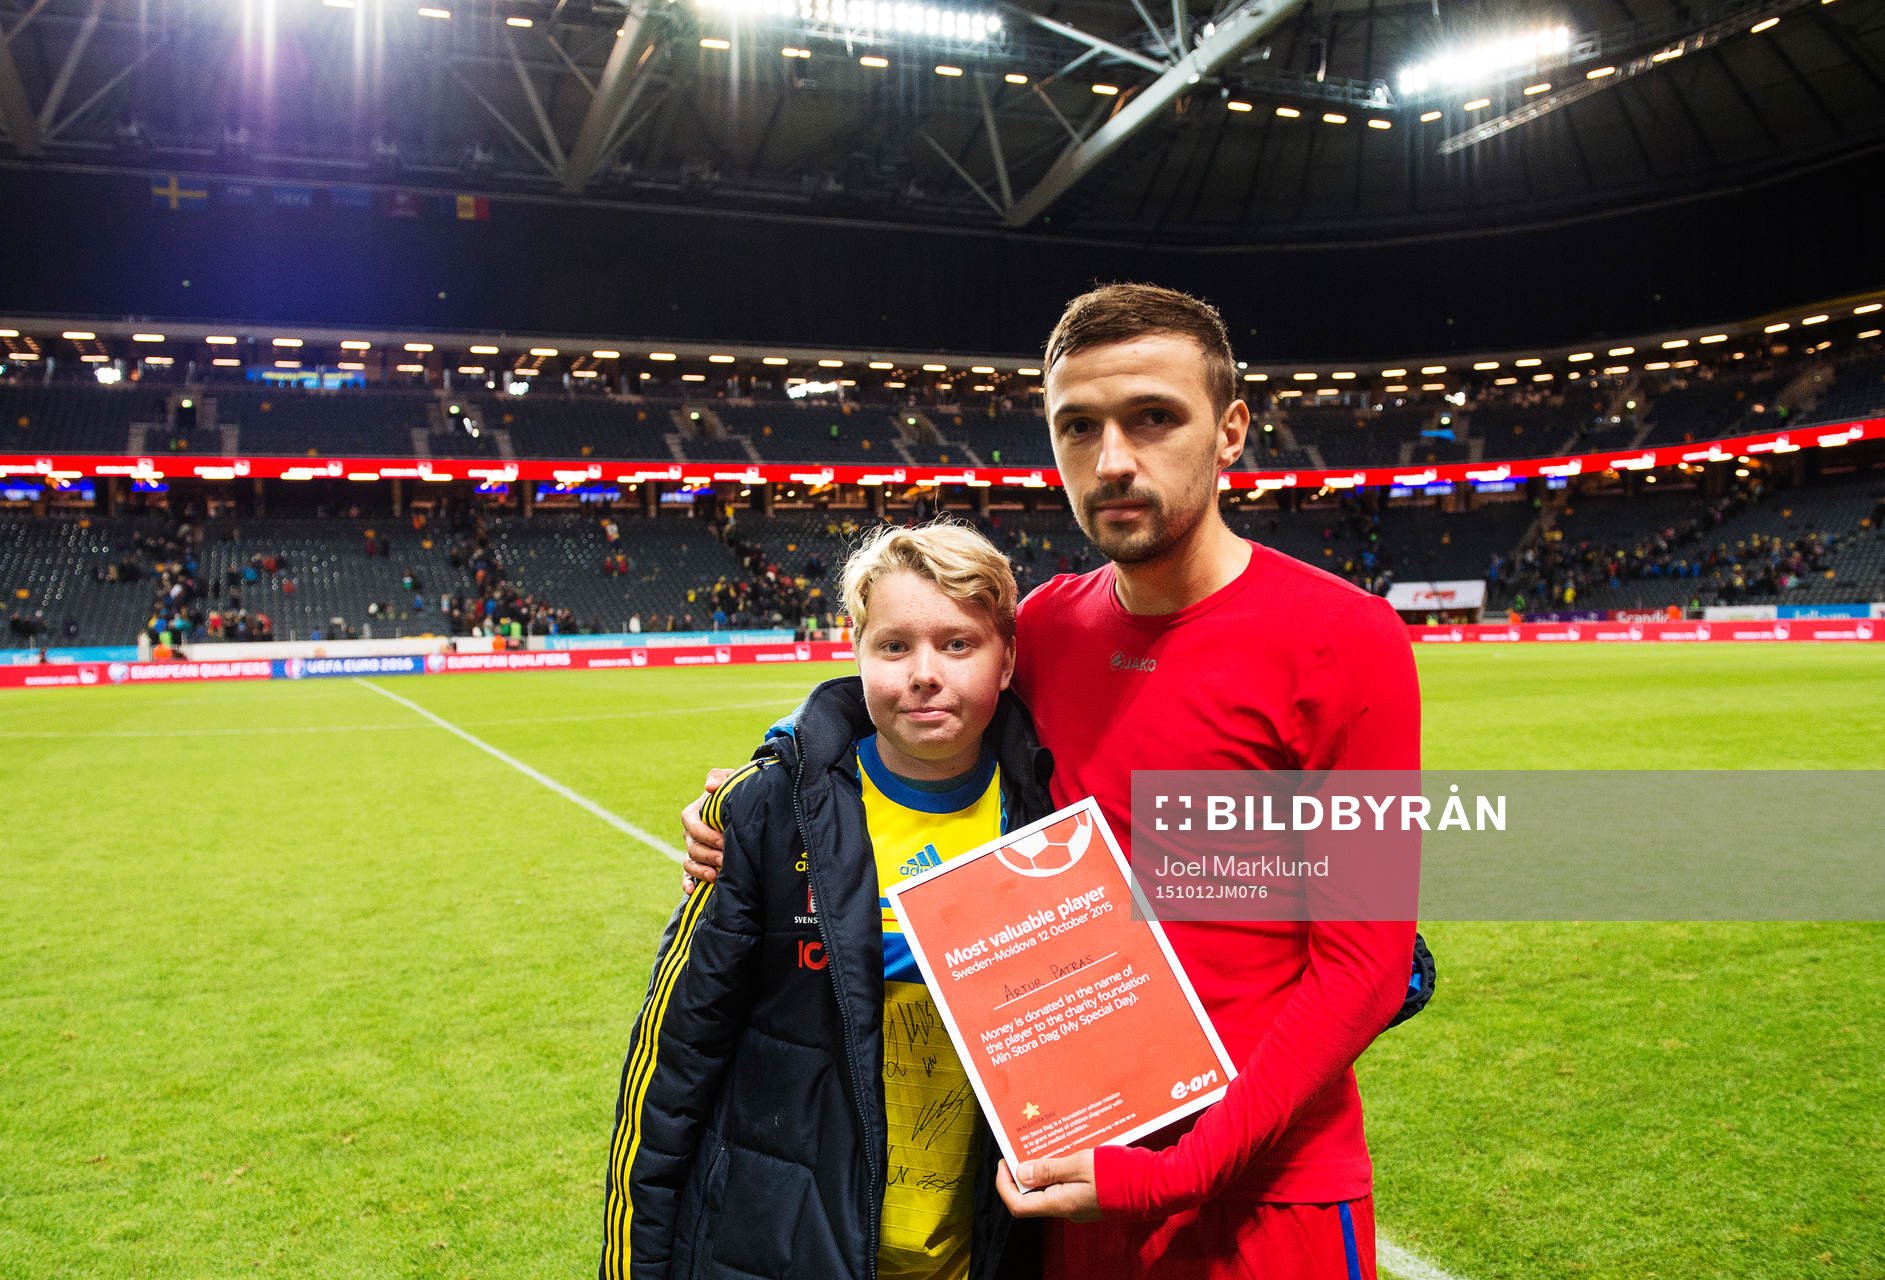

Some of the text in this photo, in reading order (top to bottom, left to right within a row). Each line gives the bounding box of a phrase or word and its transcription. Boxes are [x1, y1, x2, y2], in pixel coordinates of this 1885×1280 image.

[130, 661, 271, 680] EUROPEAN QUALIFIERS
[307, 659, 343, 674] UEFA
[343, 658, 380, 673] EURO
[447, 655, 508, 669] EUROPEAN
[508, 653, 571, 669] QUALIFIERS
[1125, 656, 1157, 672] JAKO
[944, 885, 1105, 968] Most valuable player
[951, 900, 1114, 981] Sweden-Moldova 12 October 2015
[980, 964, 1135, 1043] Money is donated in the name of
[985, 973, 1151, 1055] the player to the charity foundation
[991, 992, 1140, 1067] Min Stora Dag (My Special Day).
